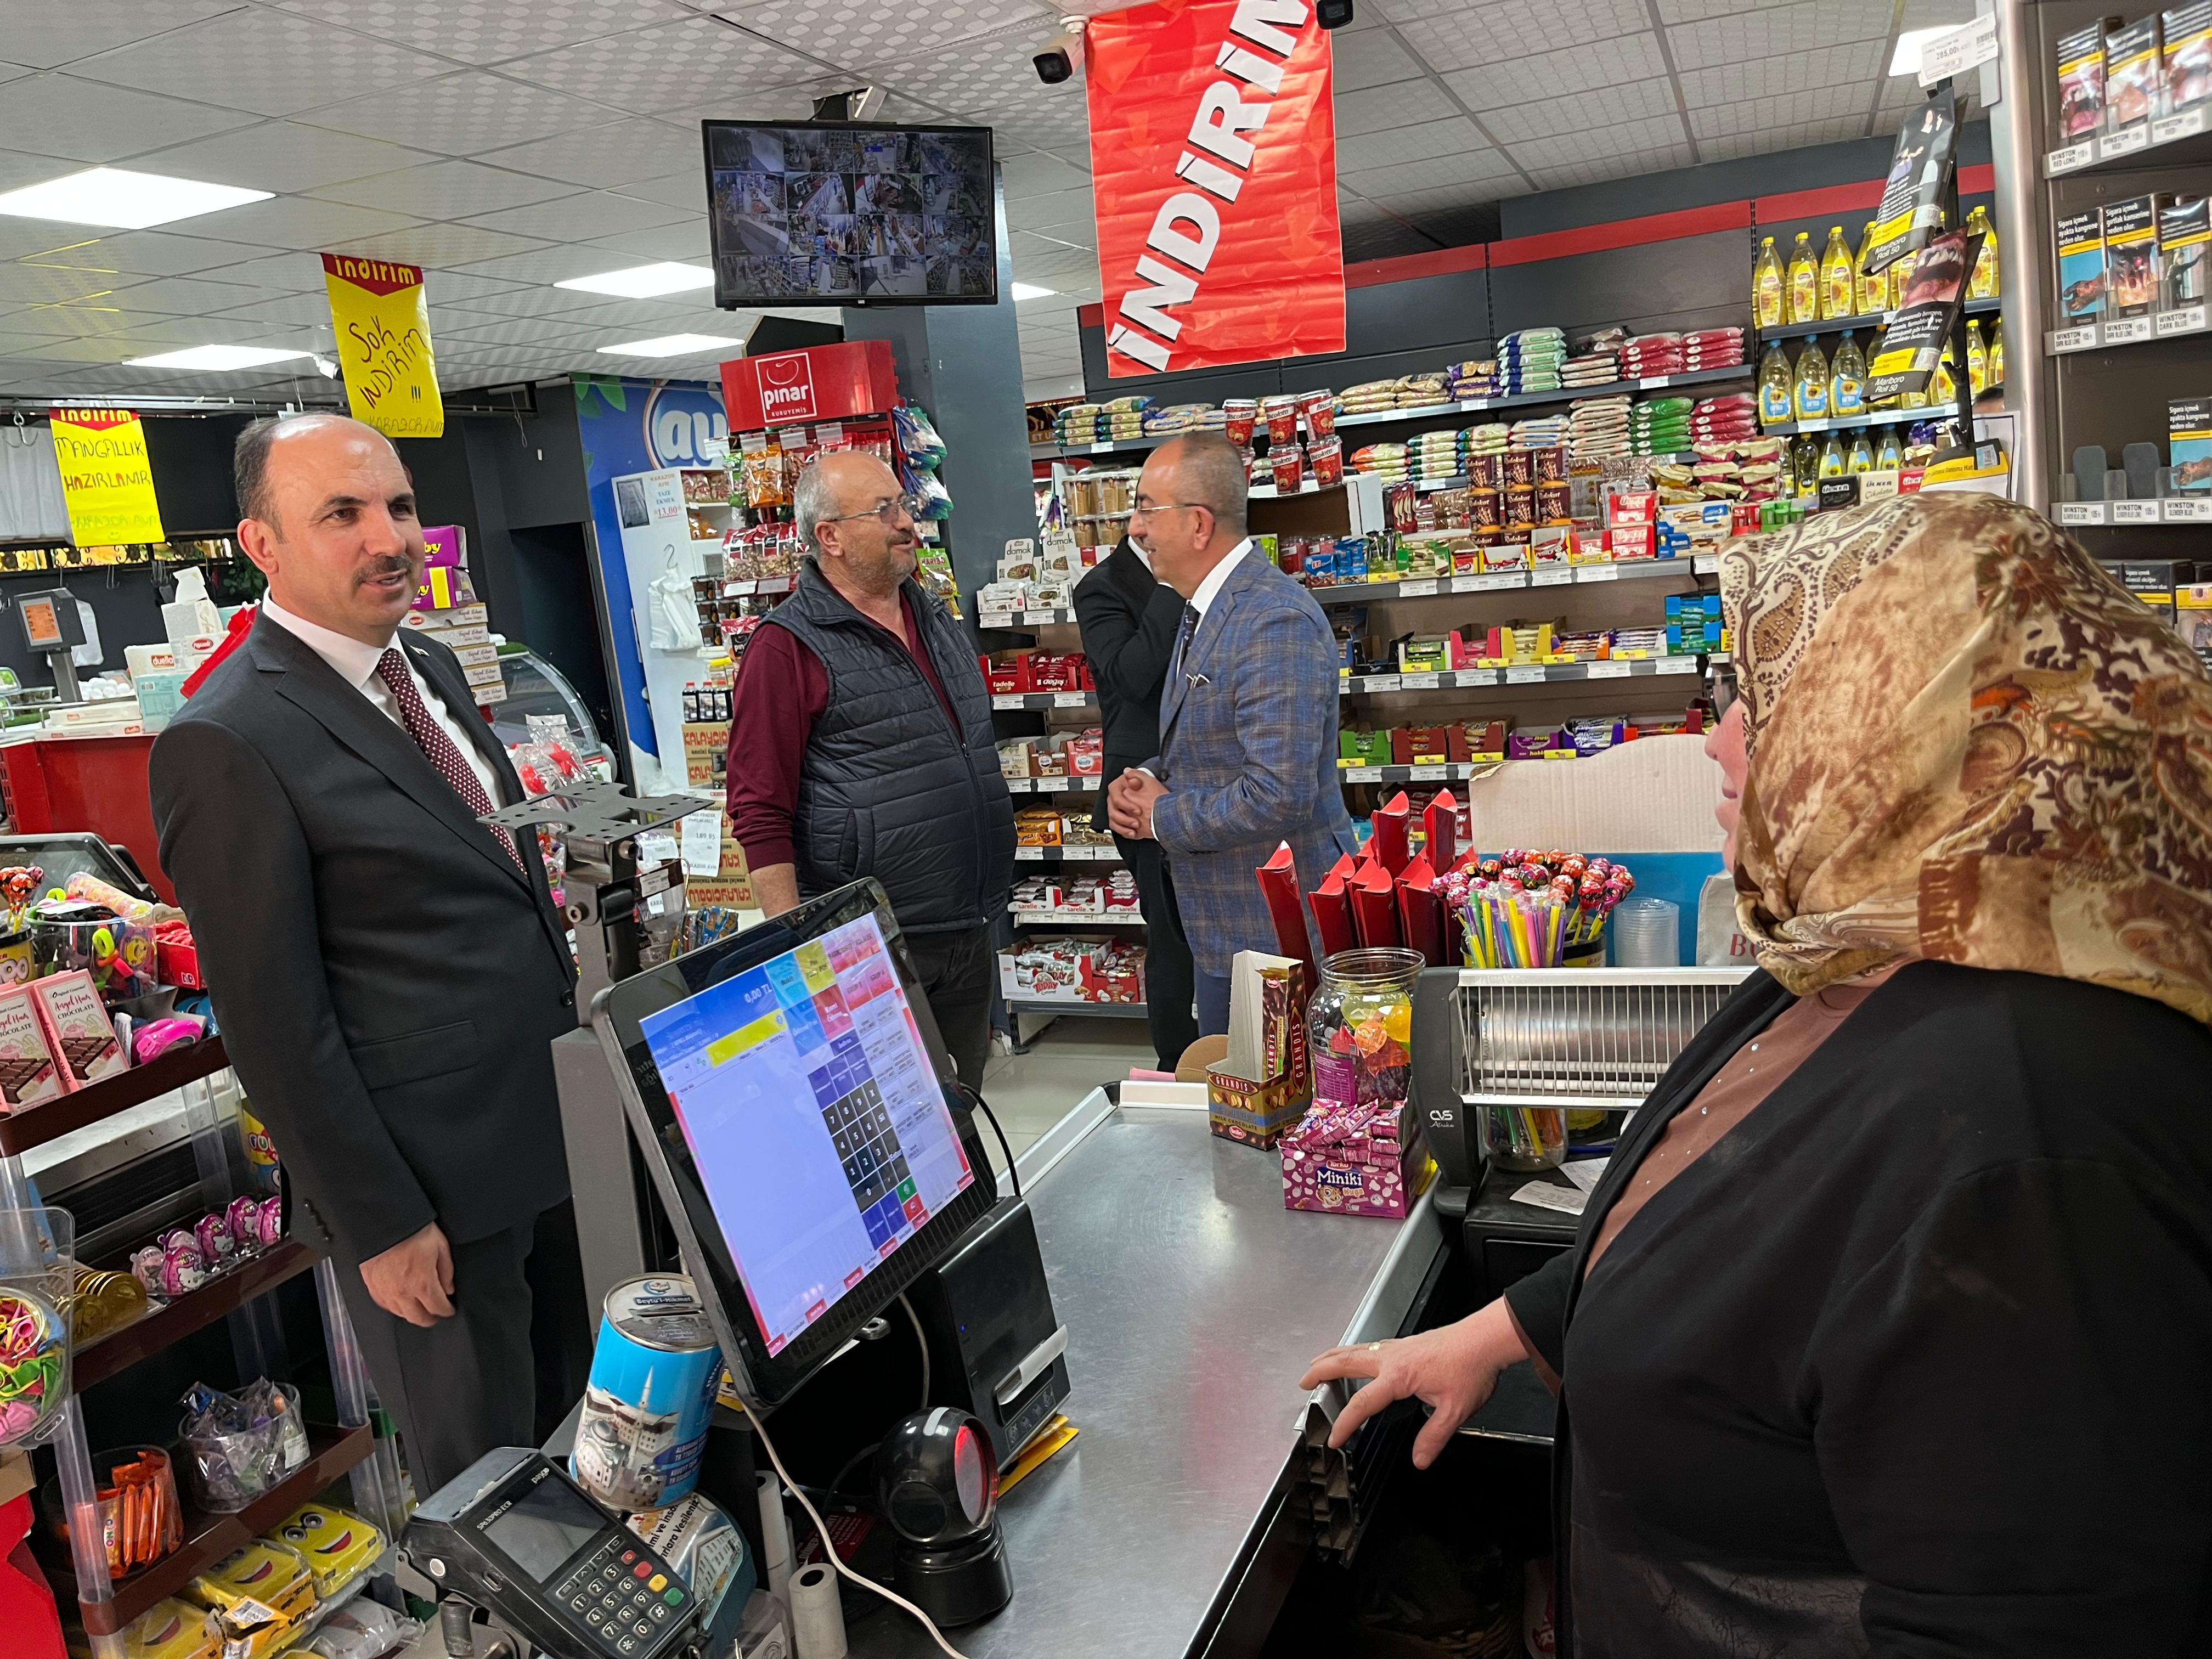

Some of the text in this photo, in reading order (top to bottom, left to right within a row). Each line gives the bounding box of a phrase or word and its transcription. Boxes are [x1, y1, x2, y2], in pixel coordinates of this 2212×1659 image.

[2051, 149, 2076, 161] WINSTON
[1875, 236, 1906, 255] Marlboro
[1877, 245, 1900, 261] Roll 50
[334, 256, 415, 285] indirim
[2158, 313, 2187, 323] WINSTON
[2107, 323, 2133, 331] WINSTON
[2159, 322, 2173, 330] DARK
[2056, 331, 2081, 340] WINSTON
[1875, 376, 1905, 386] Marlboro
[763, 385, 809, 410] pınar
[771, 406, 807, 417] KURUYEMİŞ
[55, 437, 144, 459] MANGALLIK
[658, 507, 678, 518] 13,00
[1047, 533, 1074, 546] damak
[1006, 543, 1031, 555] damak
[689, 765, 712, 780] KALA
[1032, 980, 1059, 994] TODAY
[55, 996, 75, 1012] Angel
[57, 1003, 95, 1020] CHOCOLATE
[1293, 1023, 1304, 1079] GRANDIS
[1216, 1076, 1249, 1092] GRANDIS
[1430, 1110, 1453, 1121] CVS
[1228, 1118, 1258, 1131] CHOCOLATE
[1317, 1170, 1363, 1187] Miniki
[657, 1505, 679, 1533] ve insa
[592, 1584, 602, 1593] 2
[607, 1568, 617, 1577] 3
[591, 1581, 631, 1621] 4 5 6
[606, 1595, 646, 1635] 7 8 9
[638, 1625, 647, 1634] 0
